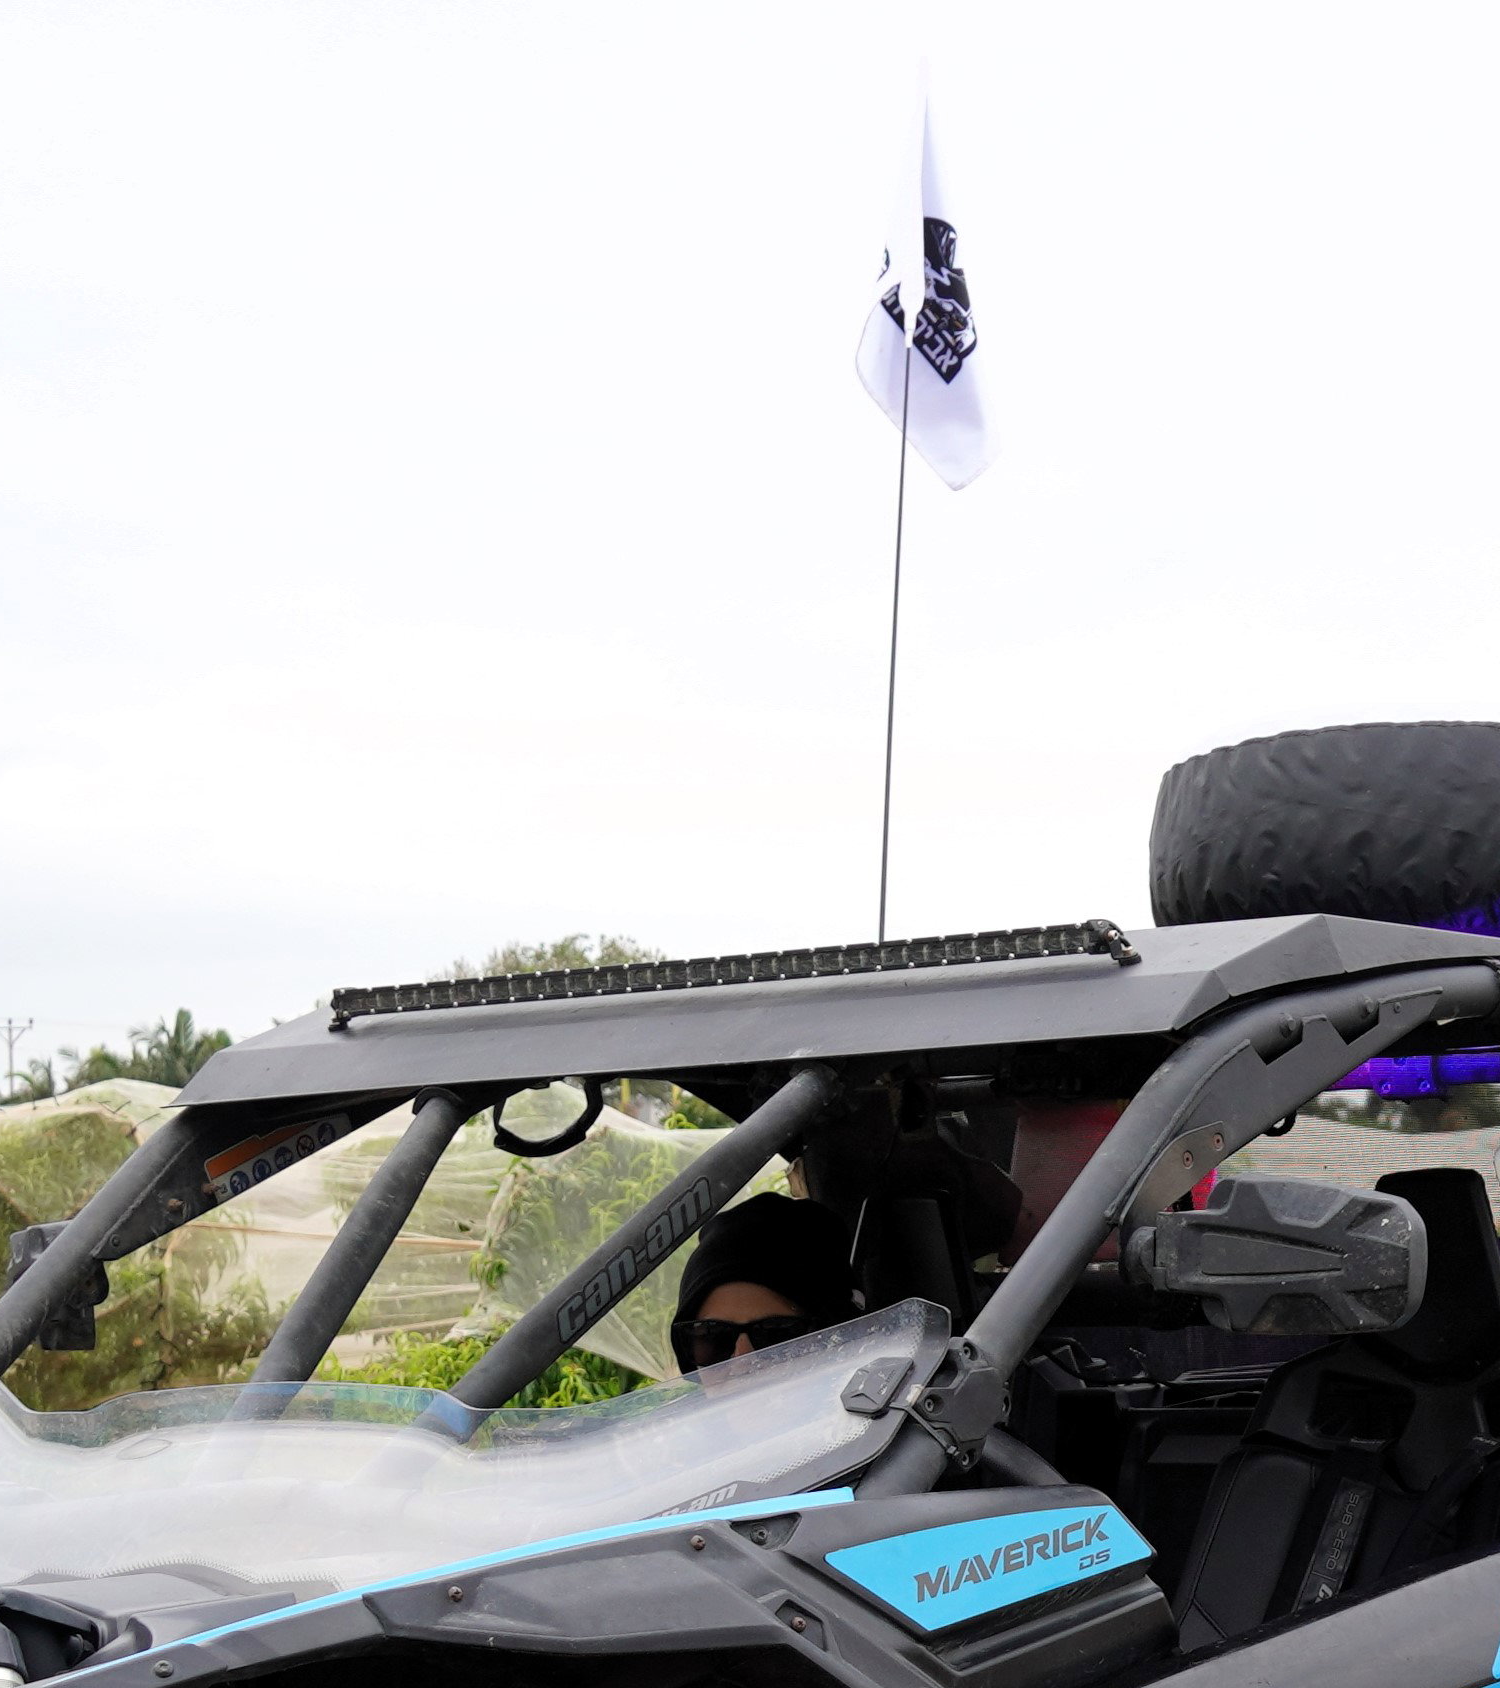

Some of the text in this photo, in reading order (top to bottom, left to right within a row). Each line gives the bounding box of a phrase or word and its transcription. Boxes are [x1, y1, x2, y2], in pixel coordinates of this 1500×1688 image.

[557, 1177, 712, 1343] can-am
[912, 1511, 1110, 1604] MAVERICK
[1078, 1548, 1112, 1571] DS
[1325, 1490, 1360, 1570] SUB ZERO
